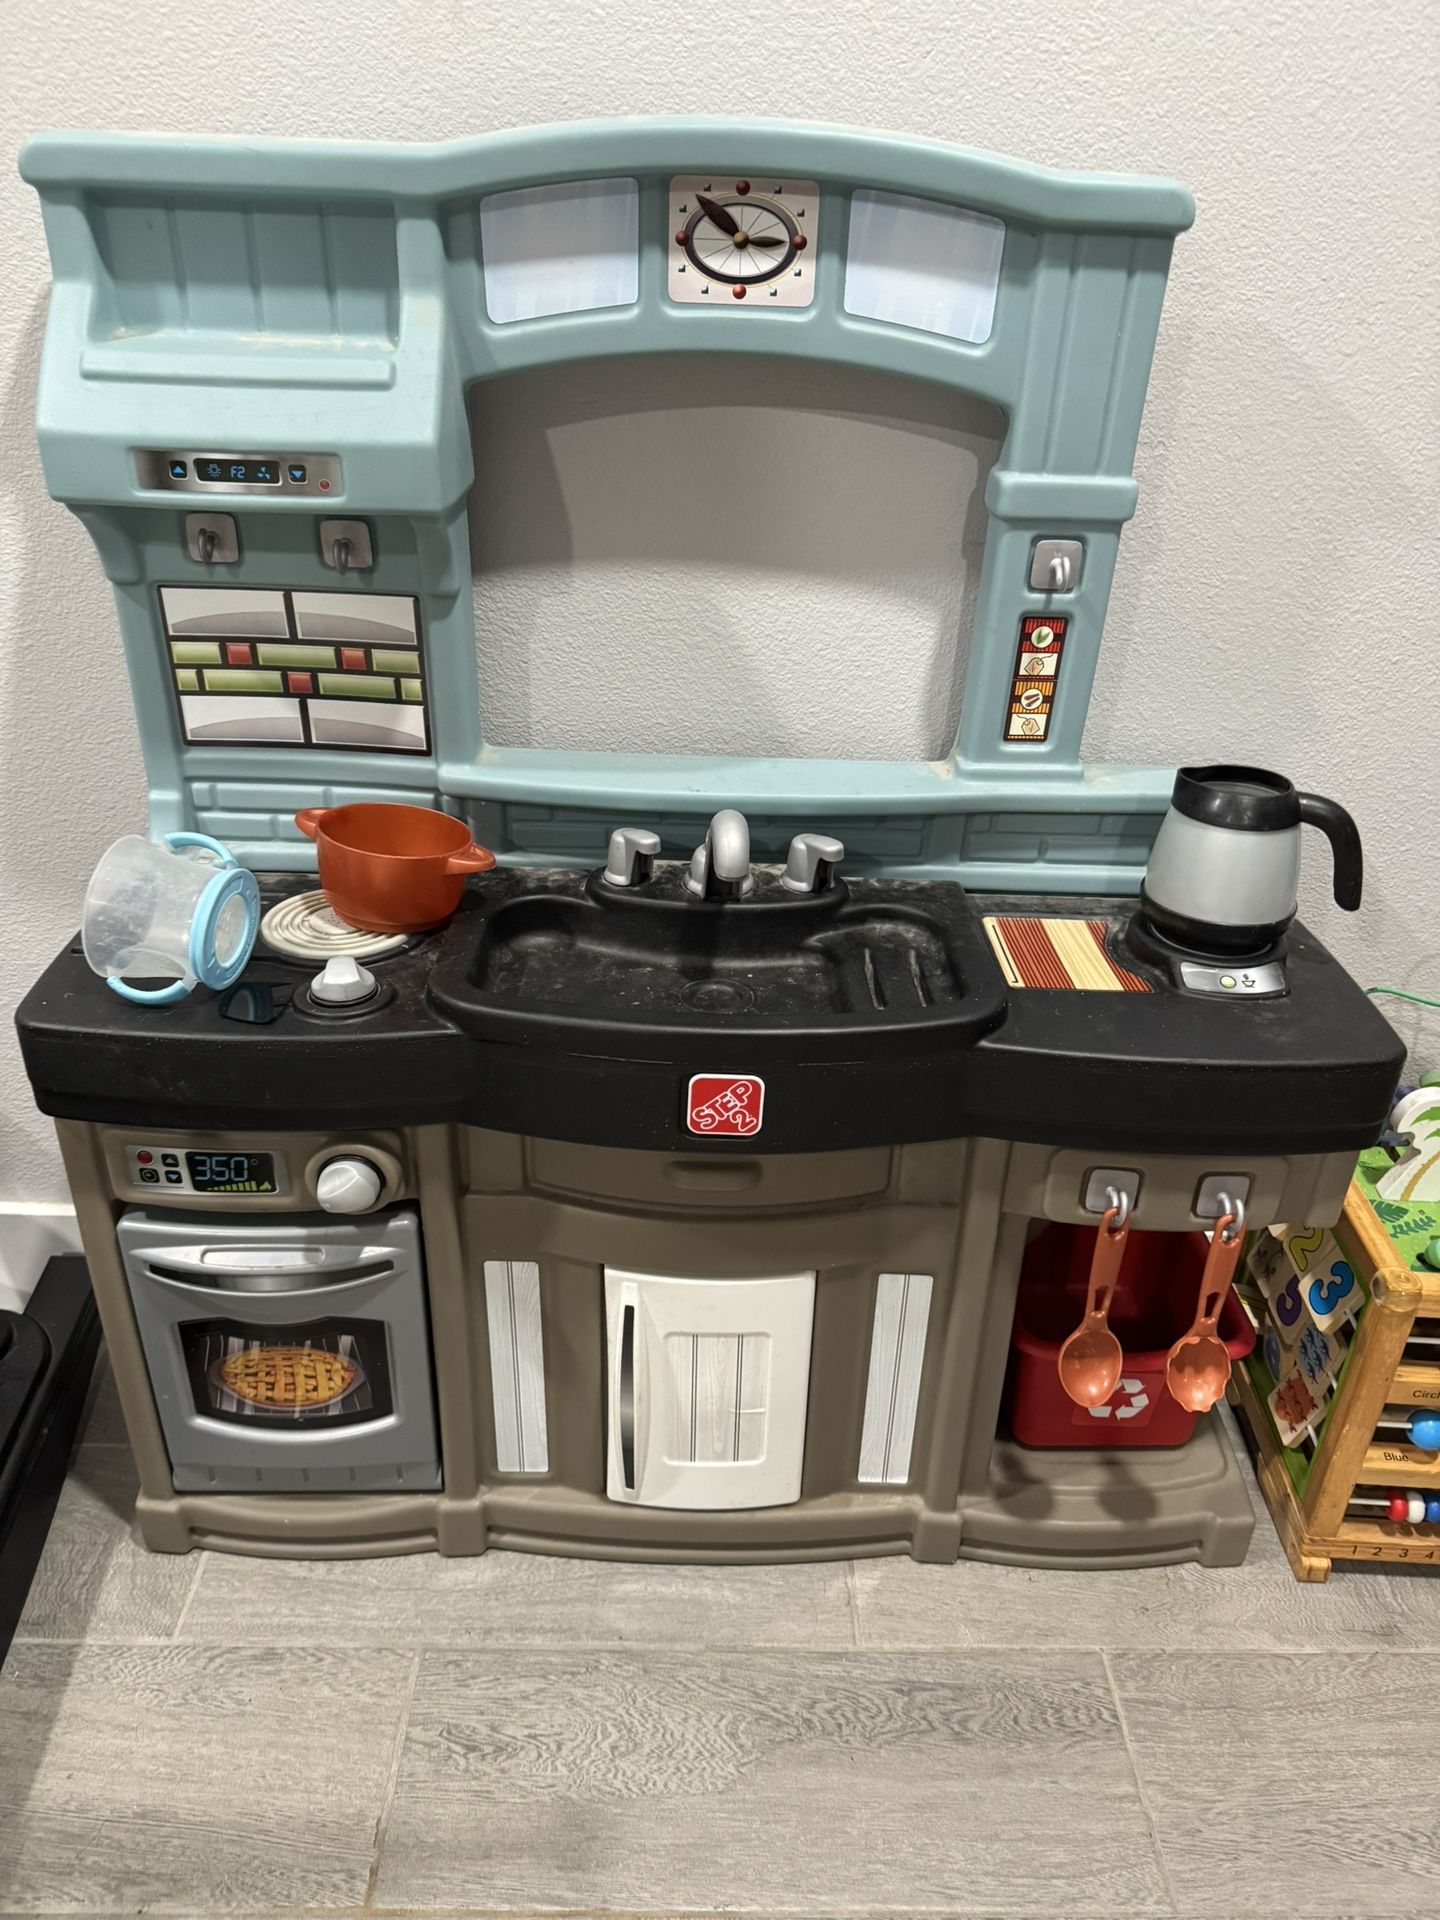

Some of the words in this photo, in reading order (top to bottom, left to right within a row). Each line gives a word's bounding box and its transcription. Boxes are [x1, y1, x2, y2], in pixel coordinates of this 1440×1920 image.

[230, 465, 246, 479] F2
[692, 1081, 752, 1130] STEP
[729, 1108, 757, 1132] 2
[1309, 1260, 1354, 1315] 3
[1383, 1452, 1409, 1462] Blue
[1352, 1545, 1358, 1555] 1
[1372, 1546, 1382, 1556] 2
[1399, 1548, 1409, 1558] 3
[1425, 1551, 1434, 1559] 4
